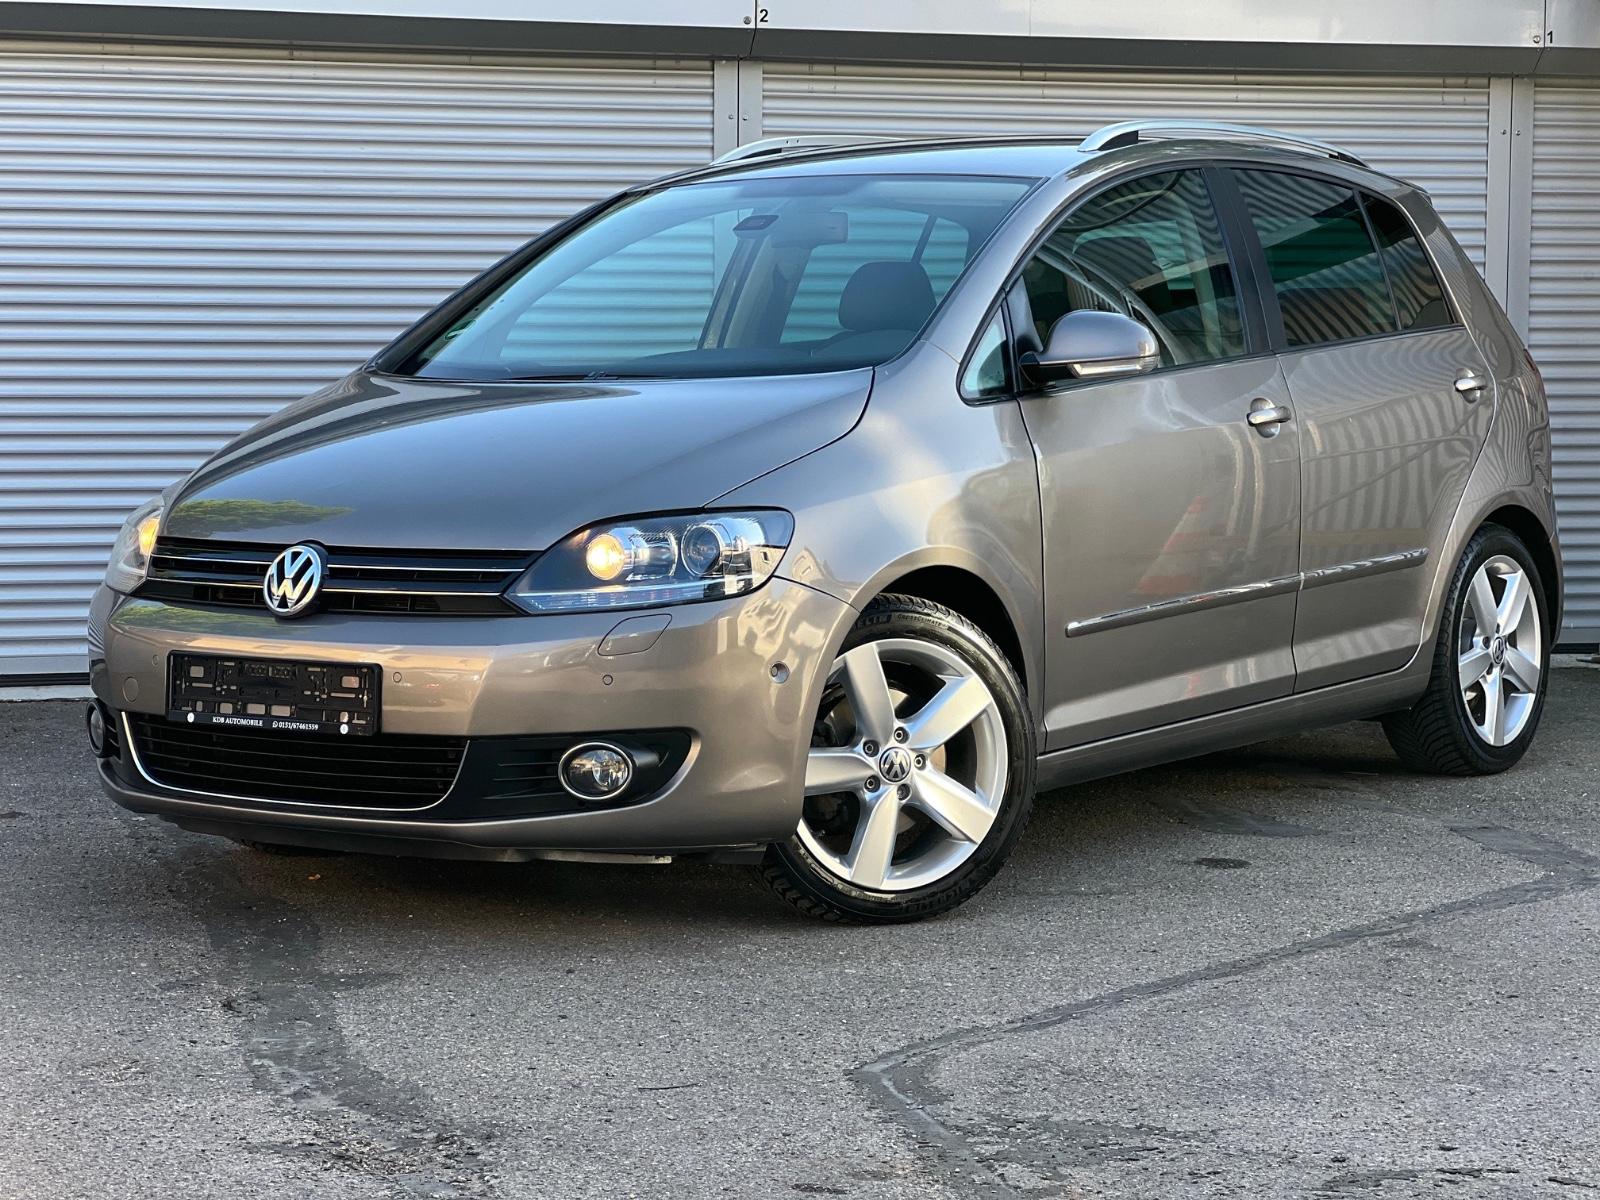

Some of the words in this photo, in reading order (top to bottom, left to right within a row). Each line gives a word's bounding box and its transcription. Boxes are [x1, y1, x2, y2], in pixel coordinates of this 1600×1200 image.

[759, 8, 769, 23] 2
[1547, 30, 1553, 44] 1
[264, 545, 321, 614] VW
[225, 717, 263, 727] AUTOMOBILE
